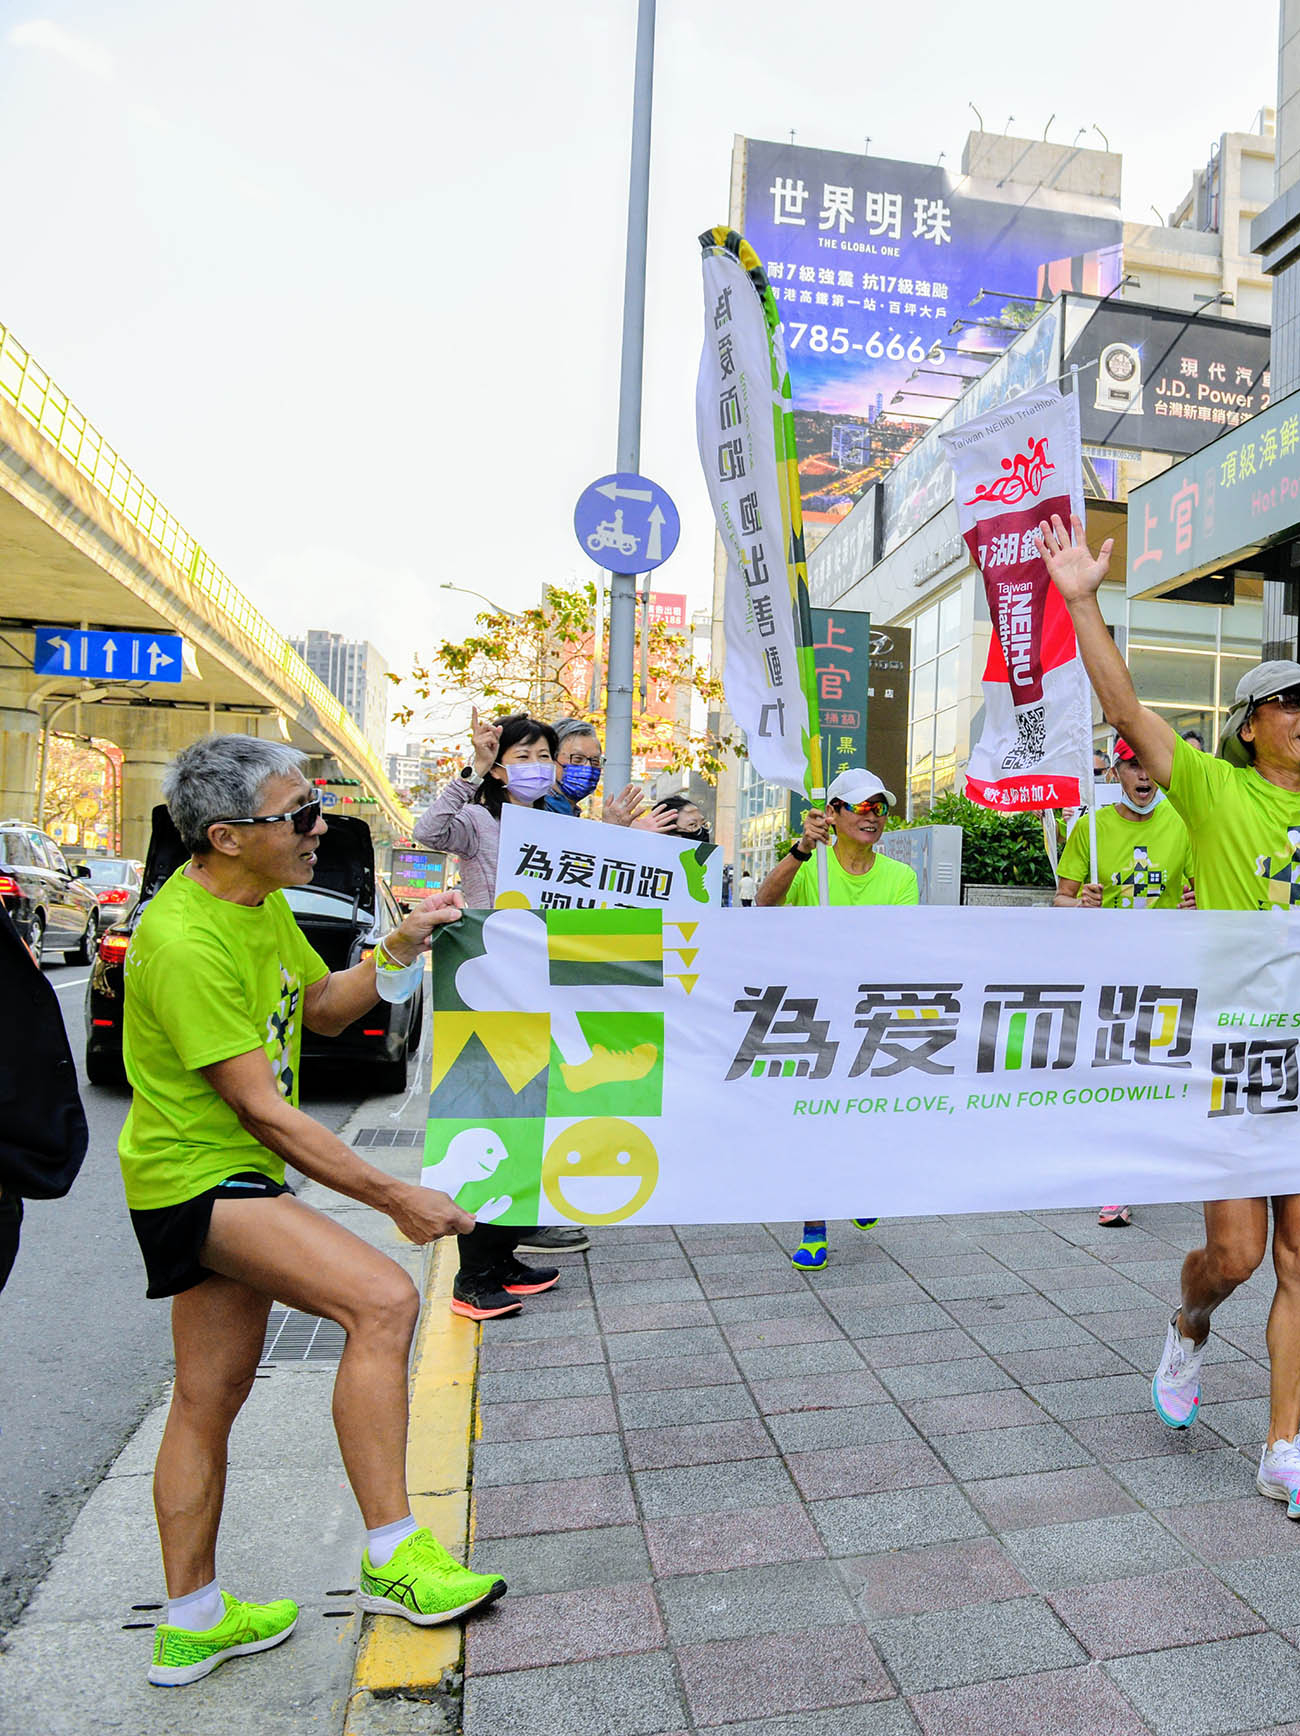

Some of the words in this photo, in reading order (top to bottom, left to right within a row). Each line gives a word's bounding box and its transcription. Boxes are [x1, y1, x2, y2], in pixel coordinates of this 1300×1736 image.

[770, 177, 951, 246] 世界明珠
[818, 238, 837, 249] THE
[841, 242, 877, 254] GLOBAL
[881, 247, 900, 257] ONE
[767, 261, 854, 288] 耐7級強震
[779, 321, 946, 365] 785-6666
[1155, 378, 1190, 399] J.D.
[1198, 383, 1253, 408] Power
[952, 432, 984, 450] Taiwan
[986, 415, 1015, 435] NEIHU
[1017, 398, 1057, 421] Triathlon
[1133, 478, 1199, 572] 上官
[997, 581, 1032, 595] Taiwan
[814, 618, 854, 699] 上官
[1011, 593, 1034, 687] NEIHU
[1251, 1012, 1288, 1028] LIFE
[793, 1098, 840, 1116] RUN
[845, 1097, 889, 1115] FOR
[893, 1095, 954, 1115] LOVE,
[966, 1091, 1012, 1110] RUN
[1017, 1089, 1058, 1108] FOR
[1062, 1085, 1176, 1105] GOODWILL
